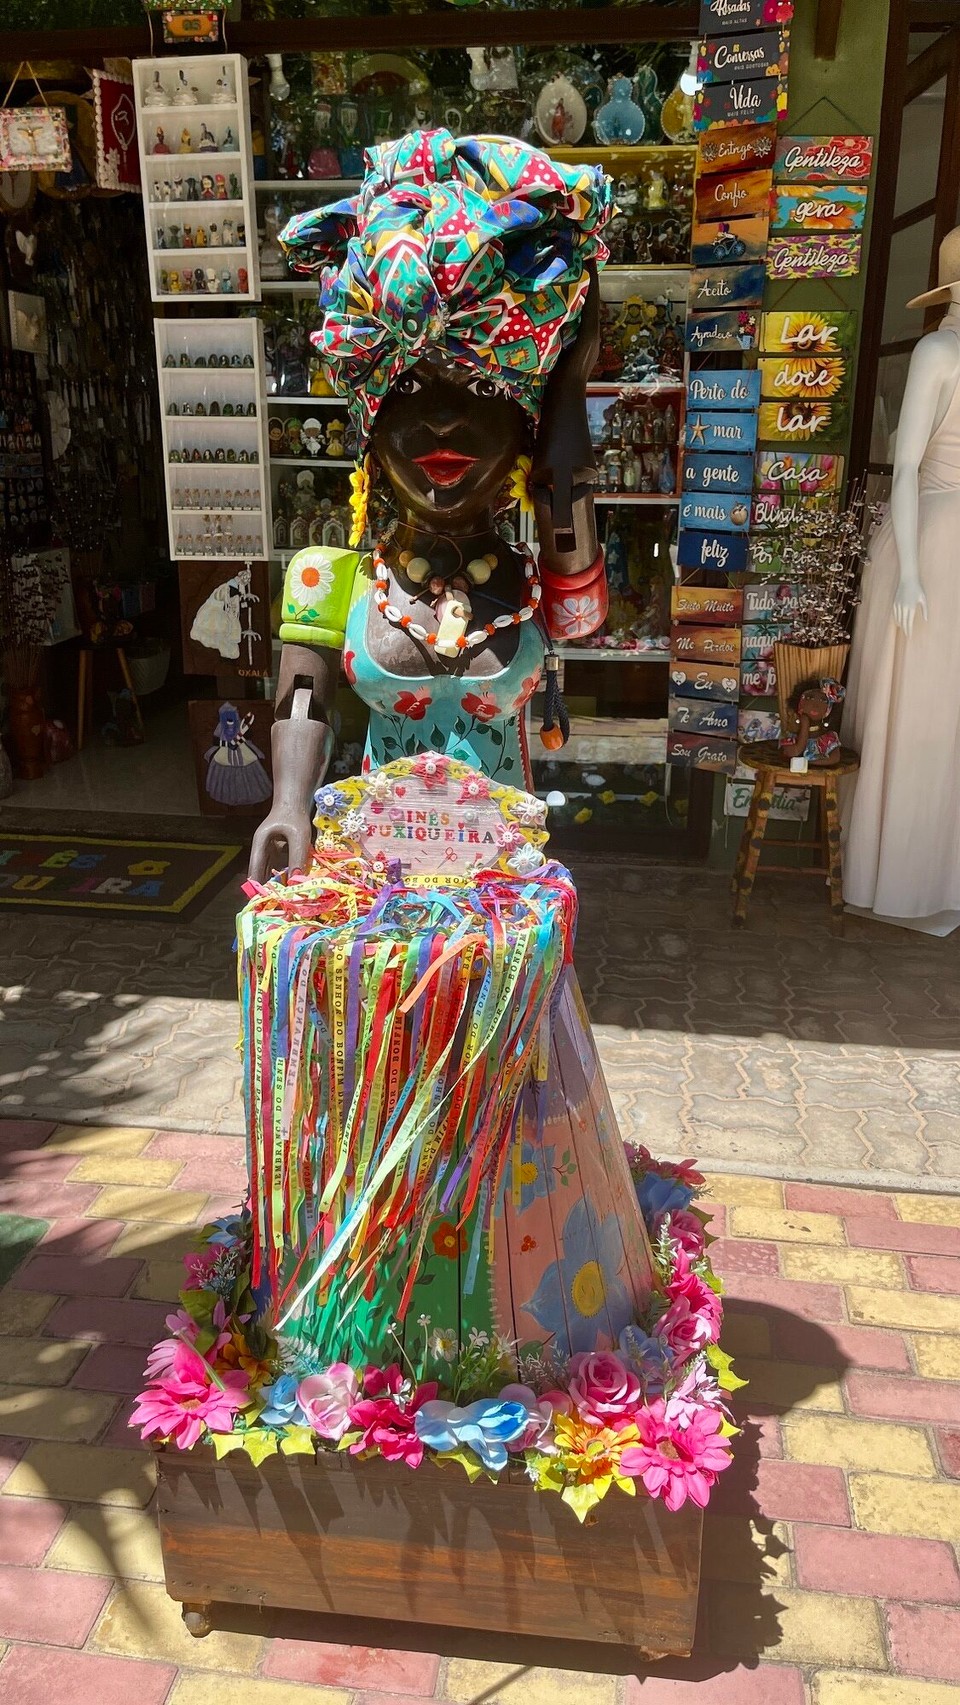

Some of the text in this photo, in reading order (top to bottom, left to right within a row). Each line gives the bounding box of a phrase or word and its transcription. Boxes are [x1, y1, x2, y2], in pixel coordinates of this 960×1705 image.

[714, 45, 765, 69] Conversas
[729, 84, 762, 110] Vida
[718, 140, 753, 161] Entrego
[784, 146, 862, 174] Gentileza
[714, 183, 747, 208] Confio
[796, 201, 844, 223] gera
[774, 246, 848, 273] Gentileza
[697, 279, 731, 299] Aceito
[780, 316, 839, 344] Lar
[774, 364, 835, 387] doce
[690, 378, 750, 401] Perto do
[713, 423, 743, 440] mar
[685, 464, 740, 488] a gente
[767, 461, 829, 484] Casa
[694, 505, 727, 521] mais
[701, 538, 729, 568] feliz
[676, 598, 735, 612] Sinto Muito
[676, 637, 695, 650] Me
[694, 671, 713, 690] Eu
[742, 672, 761, 686] me
[677, 706, 729, 728] Te Amo
[671, 743, 727, 763] Sou Grato
[406, 808, 450, 827] INÊS
[366, 824, 496, 845] FUXIQUEIRA
[501, 986, 511, 1002] DO
[508, 932, 527, 981] BONFIM
[335, 968, 343, 1015] SENHOR
[256, 1018, 262, 1033] DO
[336, 1021, 343, 1036] DO
[393, 1016, 402, 1062] BONFIM
[455, 1095, 463, 1109] DO
[471, 1022, 479, 1038] DO
[475, 969, 492, 1018] BONFIM
[255, 1038, 263, 1084] BONFIM
[336, 1041, 344, 1086] BONFIM
[391, 1068, 398, 1084] DO
[275, 1096, 282, 1112] DO
[428, 1121, 436, 1136] DO
